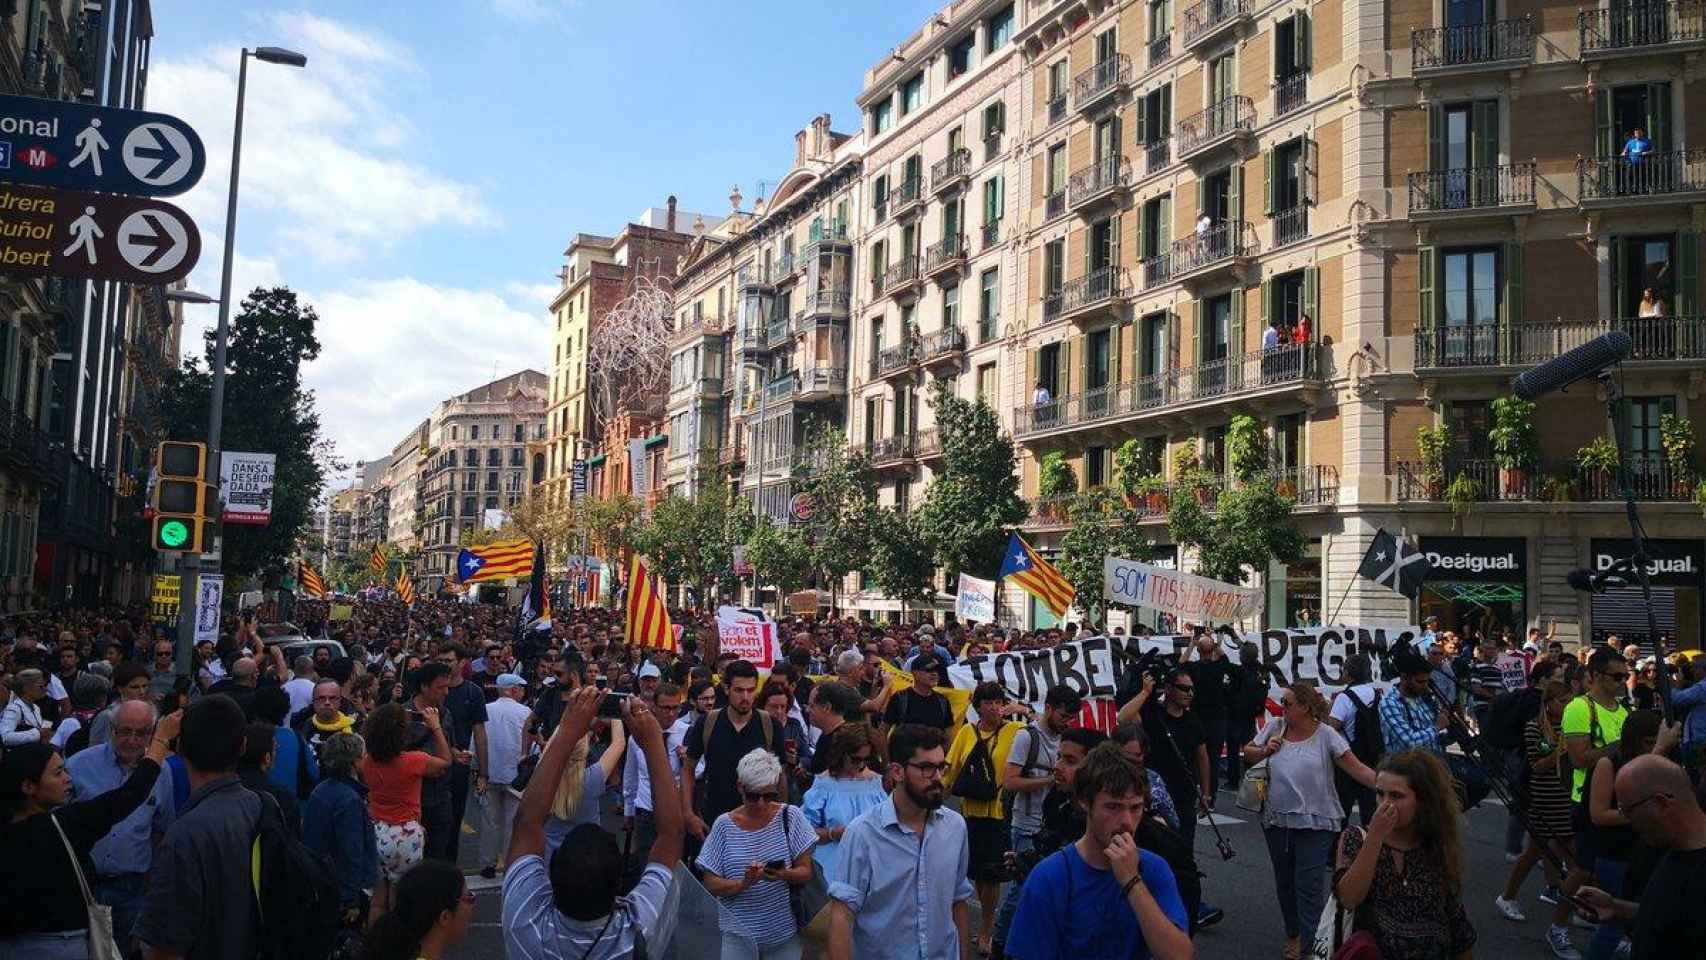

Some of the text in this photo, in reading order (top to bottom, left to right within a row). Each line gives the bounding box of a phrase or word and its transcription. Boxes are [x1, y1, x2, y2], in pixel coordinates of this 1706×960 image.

[0, 117, 58, 138] onal
[30, 149, 46, 167] M
[0, 246, 52, 266] bert
[232, 463, 268, 474] DANSA
[230, 482, 259, 492] DADA
[1112, 565, 1147, 599] SOM
